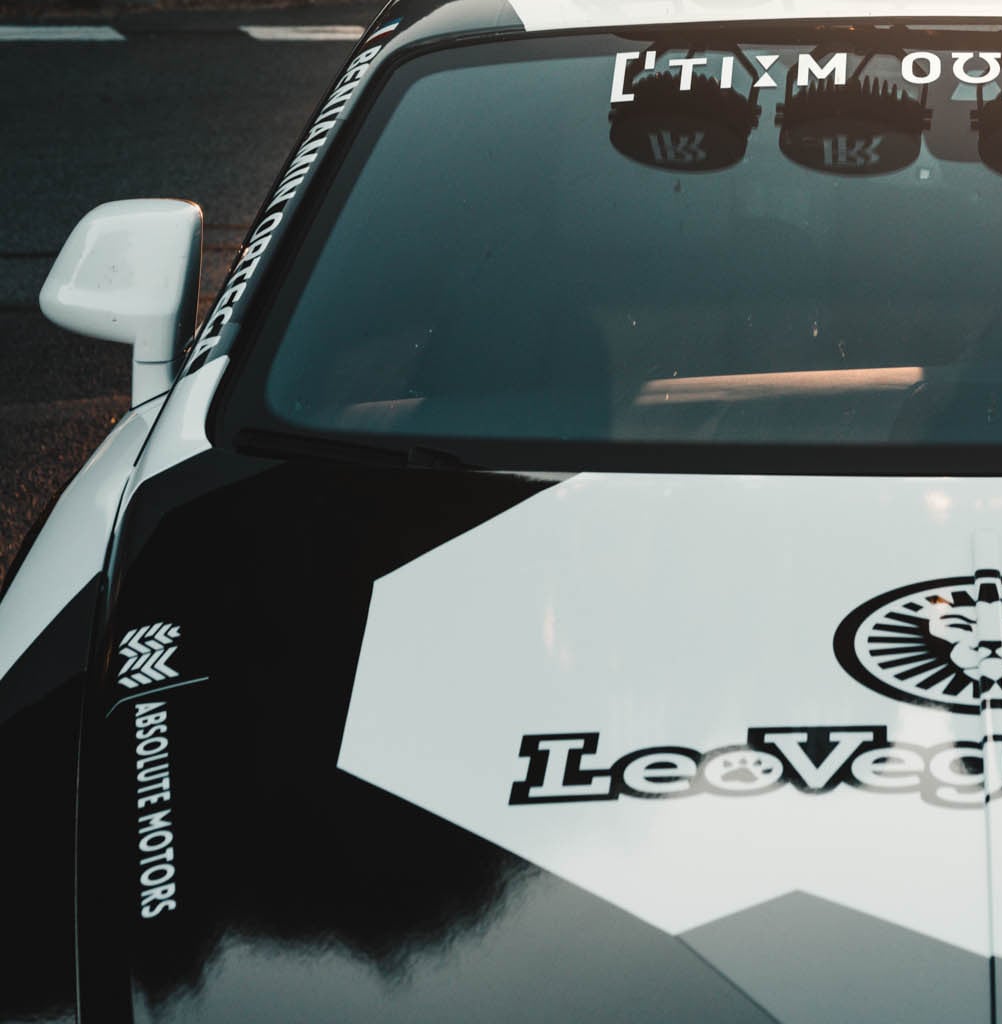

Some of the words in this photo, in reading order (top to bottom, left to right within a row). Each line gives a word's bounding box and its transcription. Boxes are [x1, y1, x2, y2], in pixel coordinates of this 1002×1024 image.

[265, 44, 382, 212] BENJAMIN
[134, 702, 171, 808] ABSOLUTE
[138, 808, 177, 919] MOTORS
